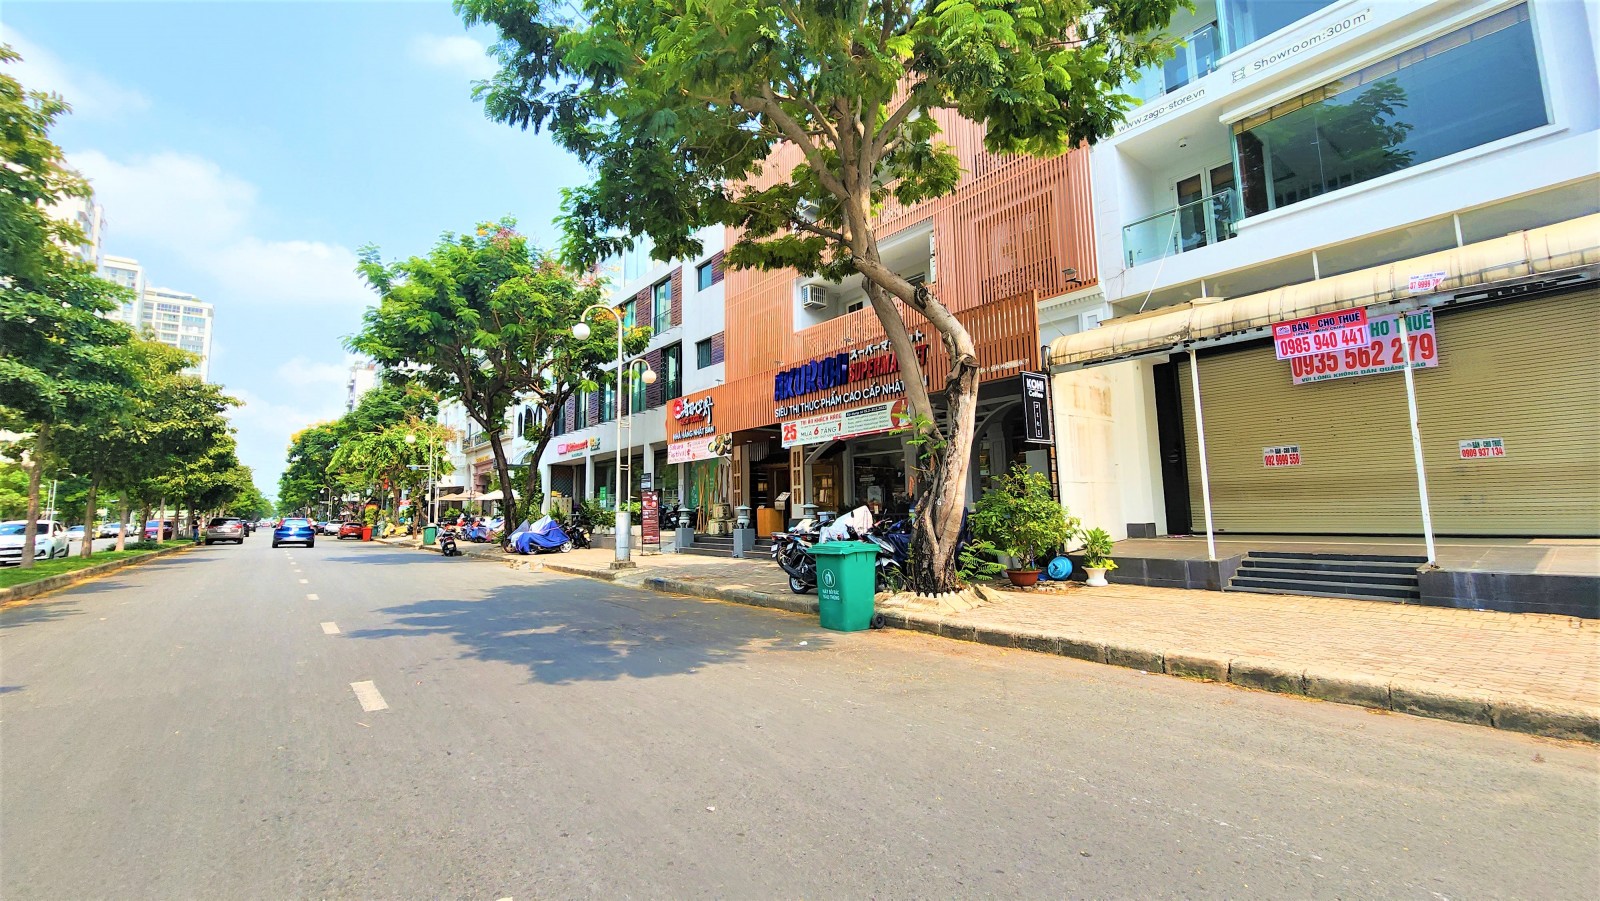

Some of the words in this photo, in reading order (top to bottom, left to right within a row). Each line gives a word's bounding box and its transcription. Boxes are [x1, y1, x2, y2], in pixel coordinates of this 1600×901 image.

[1318, 317, 1335, 328] CHO
[1338, 311, 1361, 324] THUÊ
[1369, 320, 1389, 337] HO
[1280, 337, 1311, 356] 0985
[1313, 331, 1337, 350] 940
[1341, 327, 1364, 345] 441
[1292, 352, 1339, 378] 0935
[1345, 341, 1384, 369] 562
[1391, 333, 1434, 363] 279
[1333, 370, 1359, 379] KHÔNG
[775, 405, 788, 418] SIÊU
[789, 402, 800, 416] THỊ
[800, 399, 820, 414] THỰC
[821, 391, 842, 408] PHẨM
[842, 390, 863, 403] CAO
[863, 381, 882, 400] CẤP
[1028, 390, 1044, 399] Coffee
[783, 424, 797, 441] 25
[813, 426, 819, 436] 6
[837, 422, 842, 432] 1
